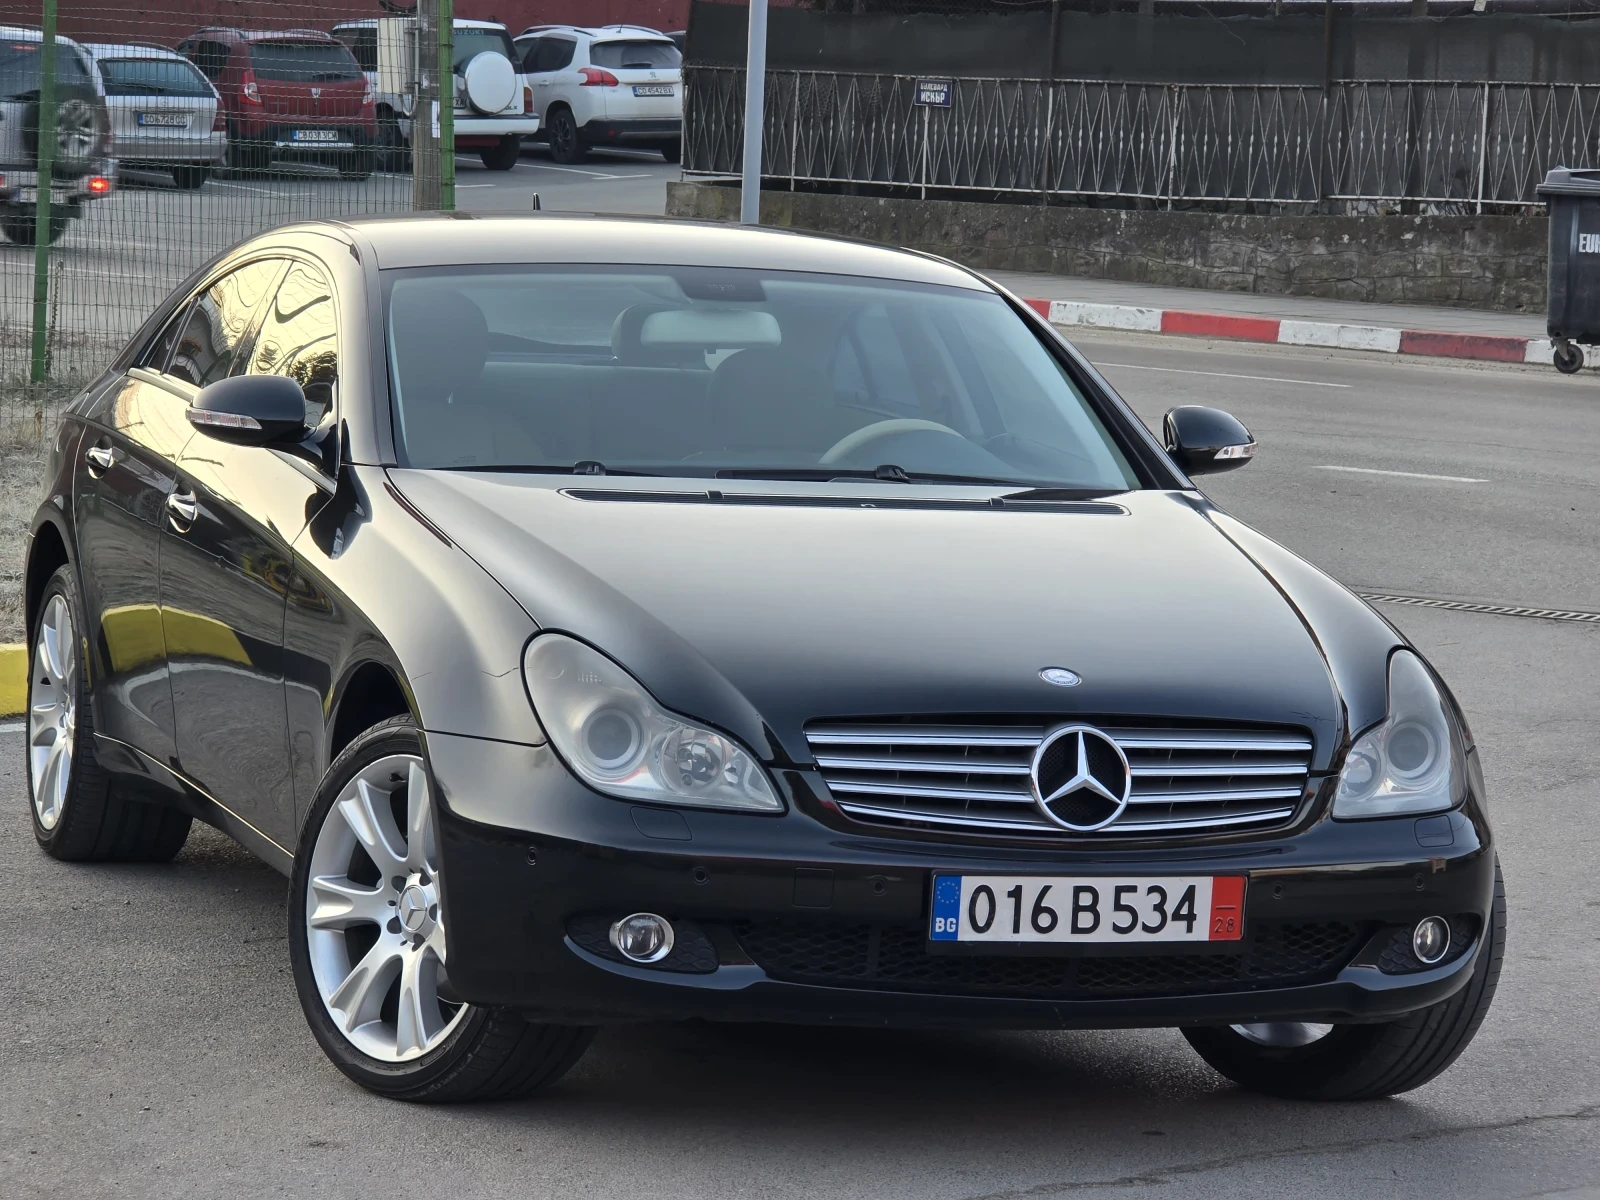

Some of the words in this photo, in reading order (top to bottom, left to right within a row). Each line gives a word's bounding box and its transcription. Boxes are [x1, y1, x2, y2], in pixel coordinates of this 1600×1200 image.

[920, 83, 948, 92] БУЛЕВАРД
[920, 91, 946, 104] ИСКЪР
[935, 917, 956, 933] BG
[1213, 916, 1236, 934] 28
